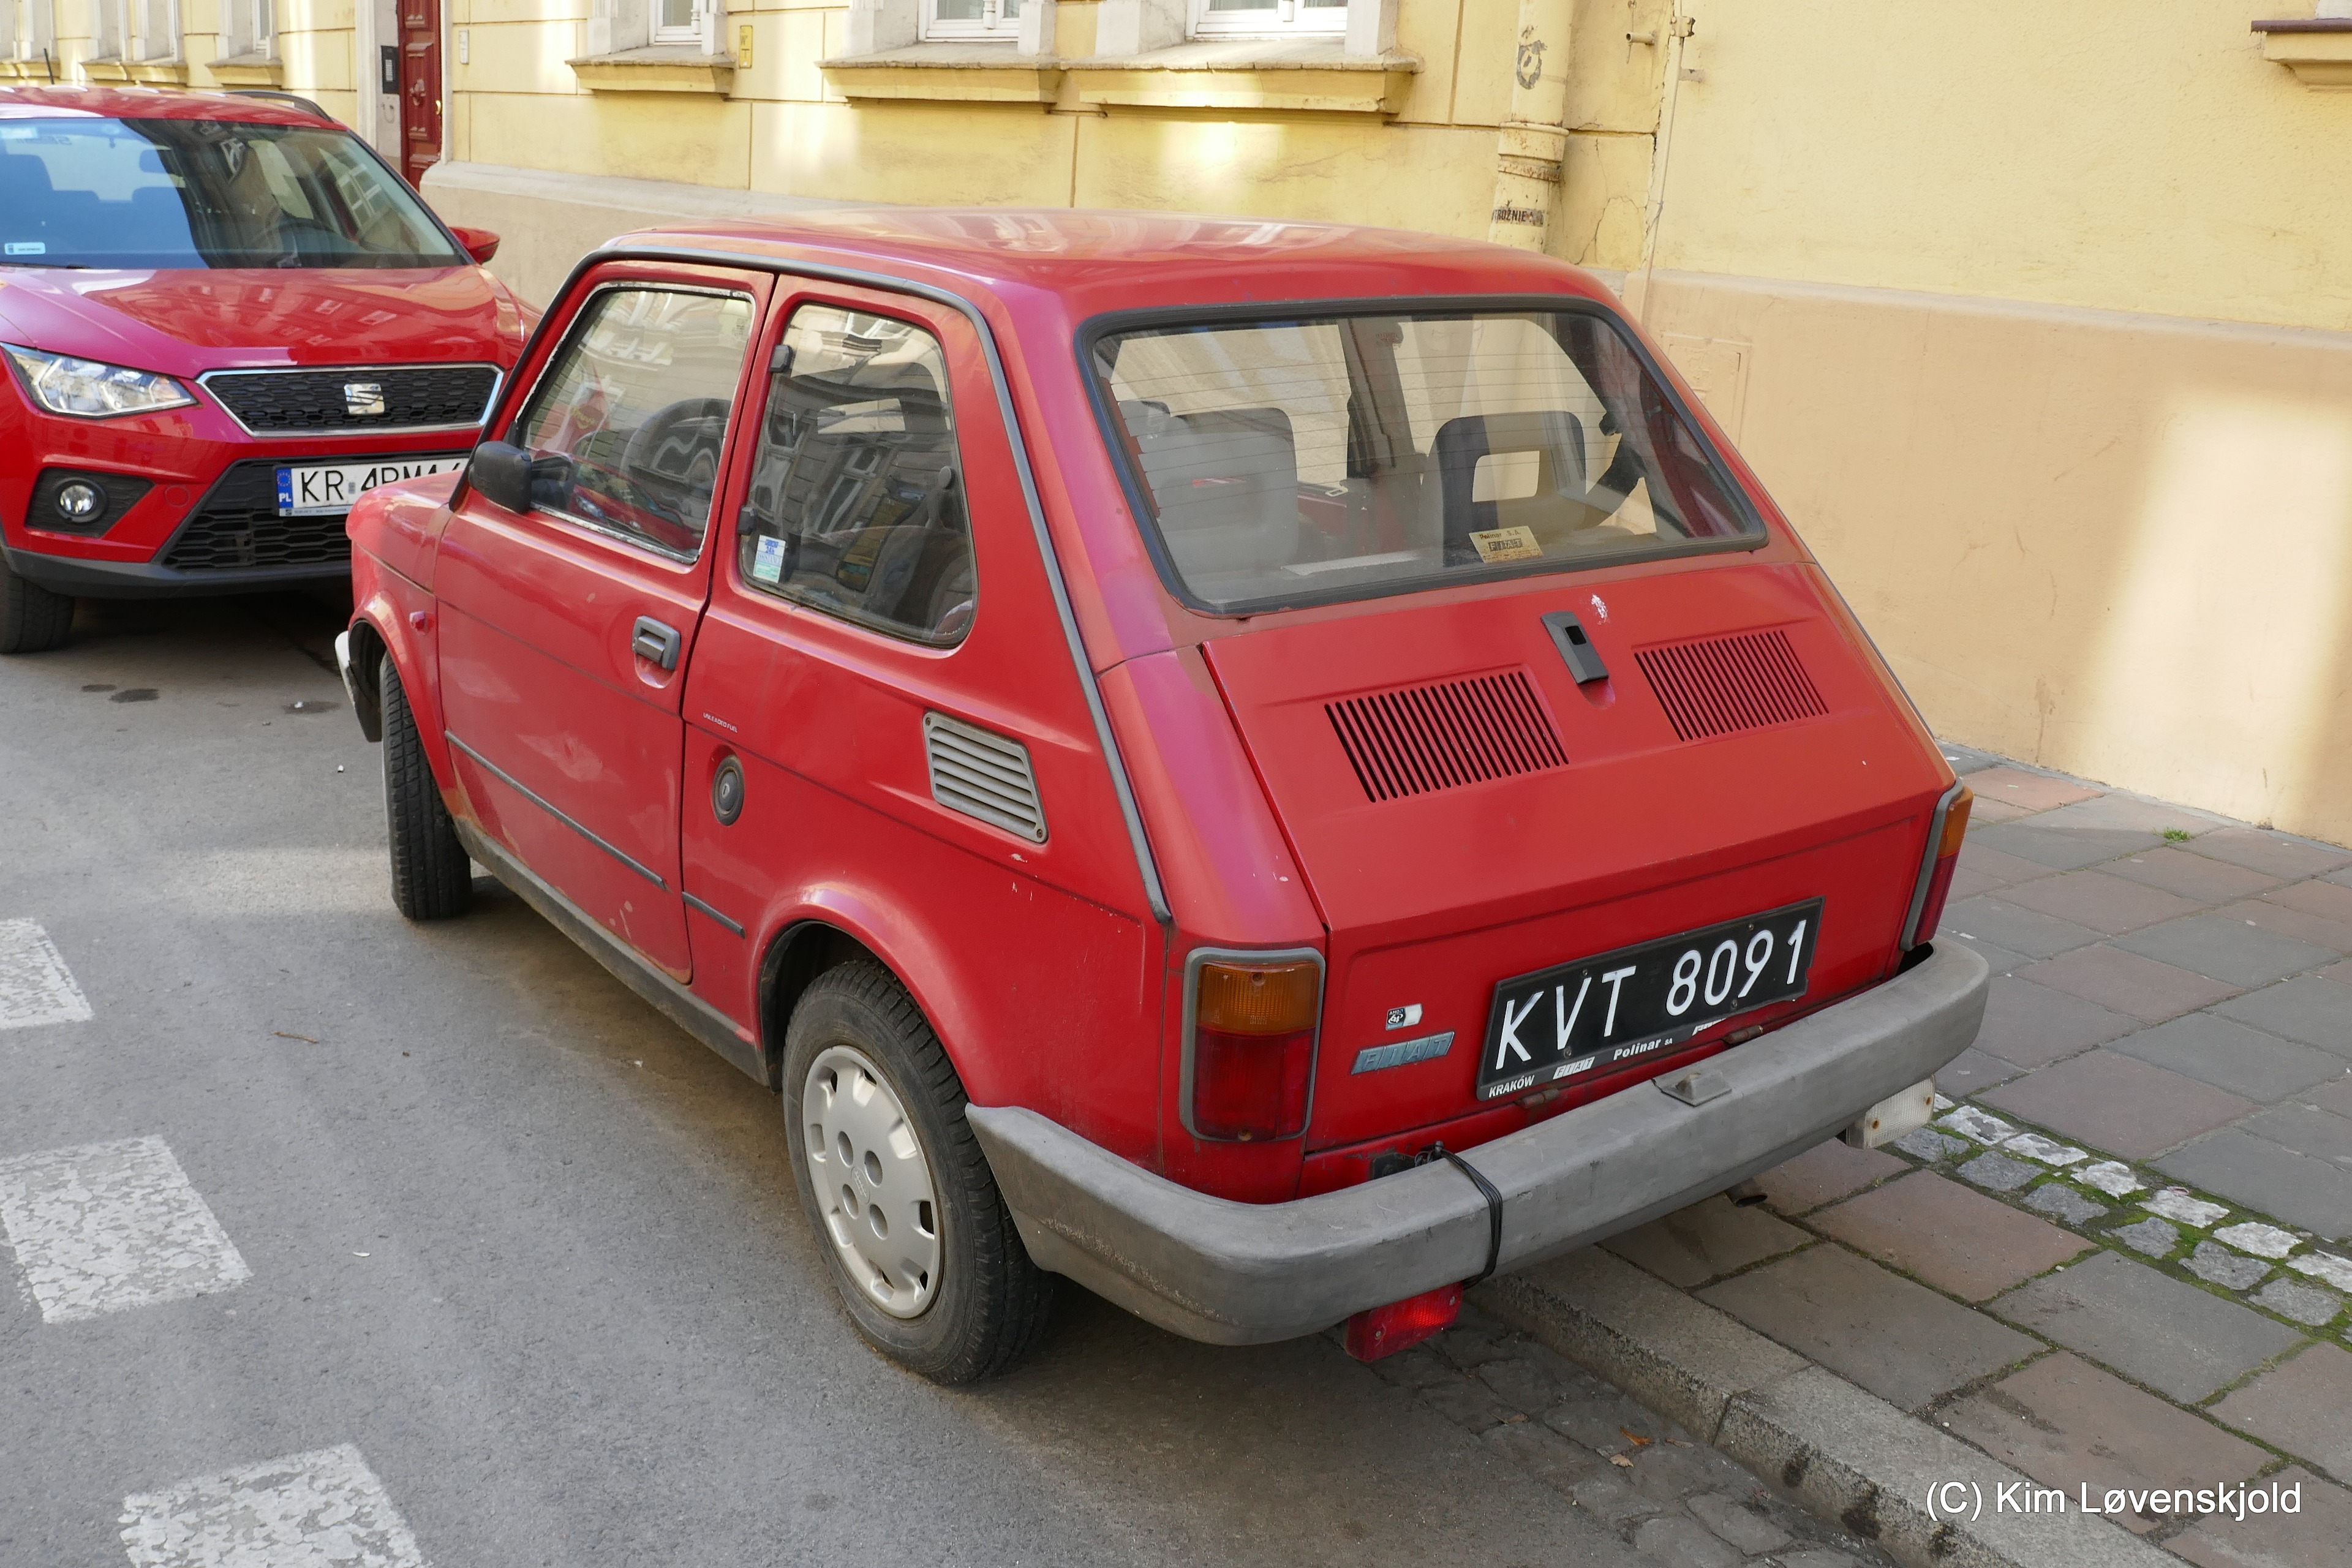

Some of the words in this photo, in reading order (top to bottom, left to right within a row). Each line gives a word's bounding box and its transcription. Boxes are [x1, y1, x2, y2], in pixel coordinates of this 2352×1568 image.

[279, 492, 292, 502] PL
[301, 470, 344, 502] KR
[1488, 538, 1523, 551] FIAT
[703, 712, 727, 728] UNLEADED
[726, 723, 738, 733] FUEL
[1496, 965, 1636, 1070] KVT
[1666, 920, 1807, 1016] 8091
[1356, 1034, 1451, 1073] FIAT
[1613, 1038, 1661, 1061] Polinar
[1553, 1056, 1596, 1080] FIAT
[1488, 1075, 1535, 1098] KRAKÓW
